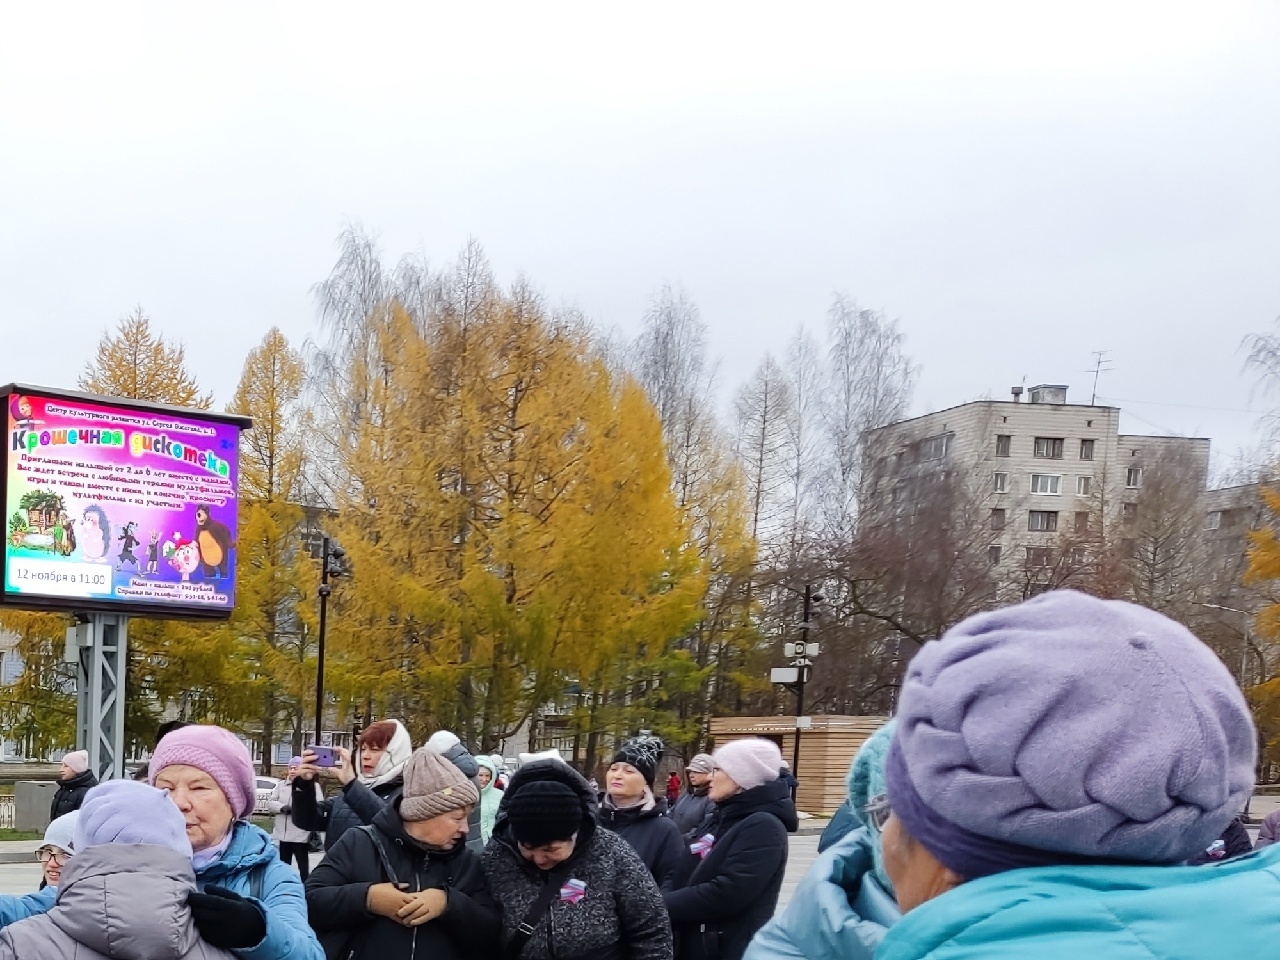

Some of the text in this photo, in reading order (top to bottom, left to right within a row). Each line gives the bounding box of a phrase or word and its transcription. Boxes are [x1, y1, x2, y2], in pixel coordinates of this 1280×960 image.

[12, 429, 228, 477] Крошечная дискотека
[16, 463, 32, 472] Вас
[21, 453, 73, 467] Приглашаем
[126, 466, 132, 474] 2
[16, 568, 106, 585] 12 ноября в 11:00
